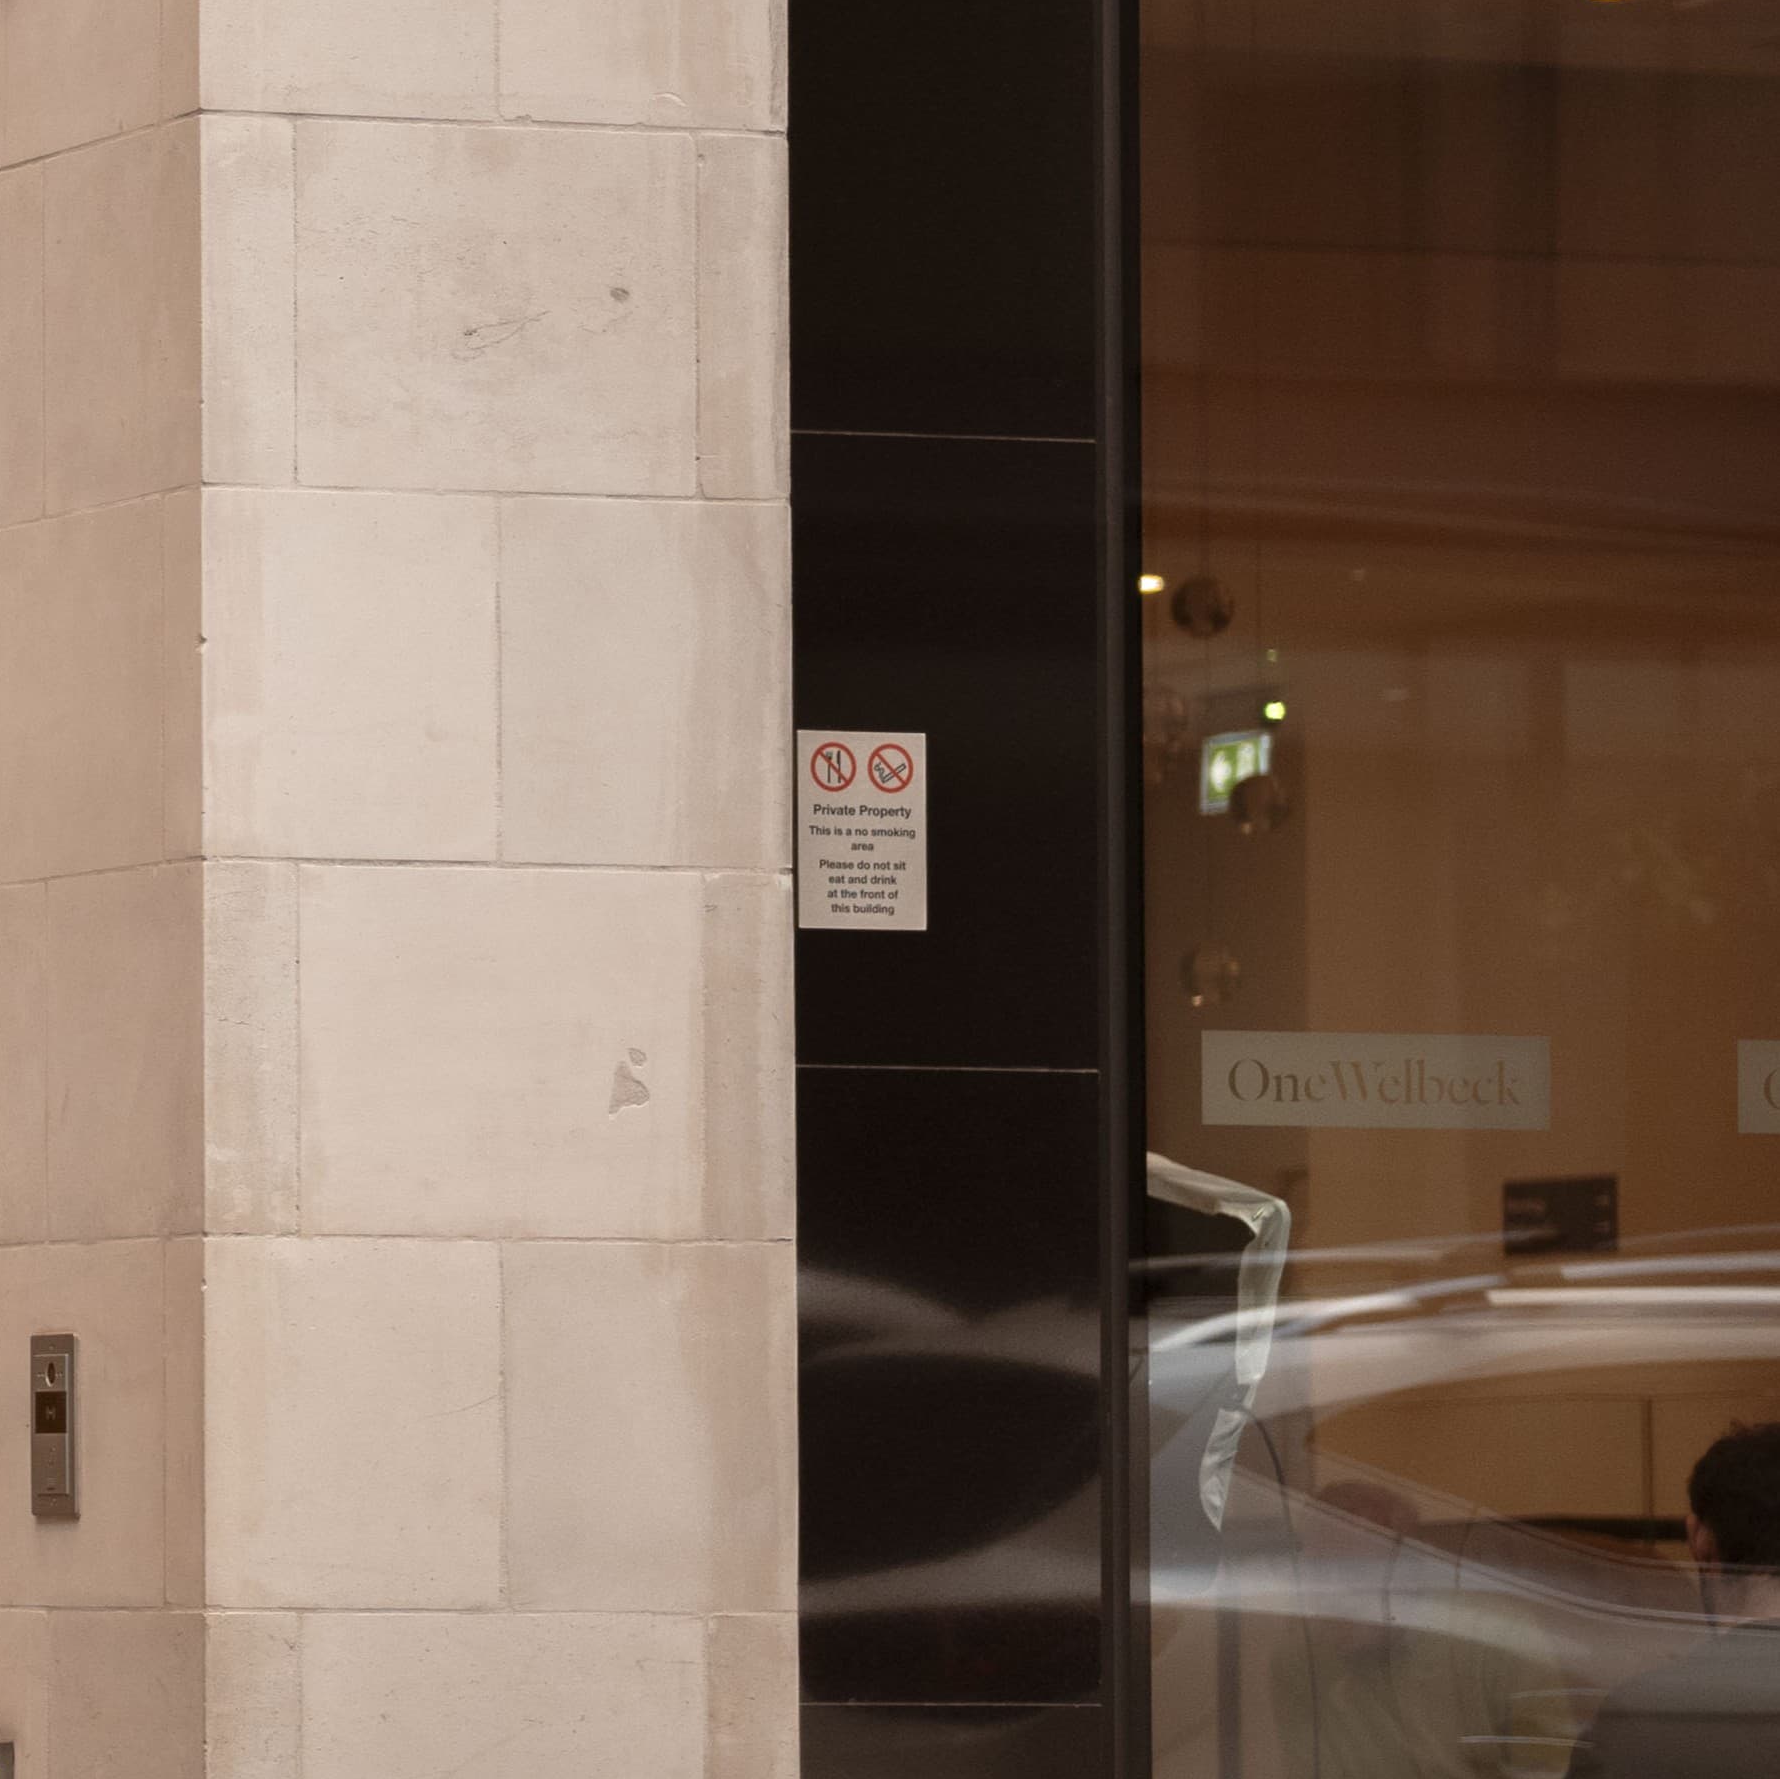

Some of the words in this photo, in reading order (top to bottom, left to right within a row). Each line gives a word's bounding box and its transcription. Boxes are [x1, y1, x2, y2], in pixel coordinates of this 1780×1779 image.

[813, 804, 856, 816] Private
[859, 805, 912, 819] Property
[809, 825, 831, 836] This
[834, 825, 843, 836] is
[845, 828, 852, 837] a
[855, 828, 868, 837] no
[871, 826, 916, 839] smoking
[851, 843, 874, 851] area
[819, 860, 854, 870] Please
[857, 860, 871, 870] do
[873, 861, 891, 870] not
[894, 861, 906, 870] sit
[828, 876, 845, 884] eat
[848, 875, 868, 884] and
[870, 875, 897, 885] drink
[827, 890, 838, 898] at
[841, 889, 858, 899] the
[860, 889, 885, 899] front
[888, 890, 899, 899] of
[831, 903, 850, 913] this
[853, 904, 895, 915] building
[1228, 1058, 1521, 1106] OneWelbeck
